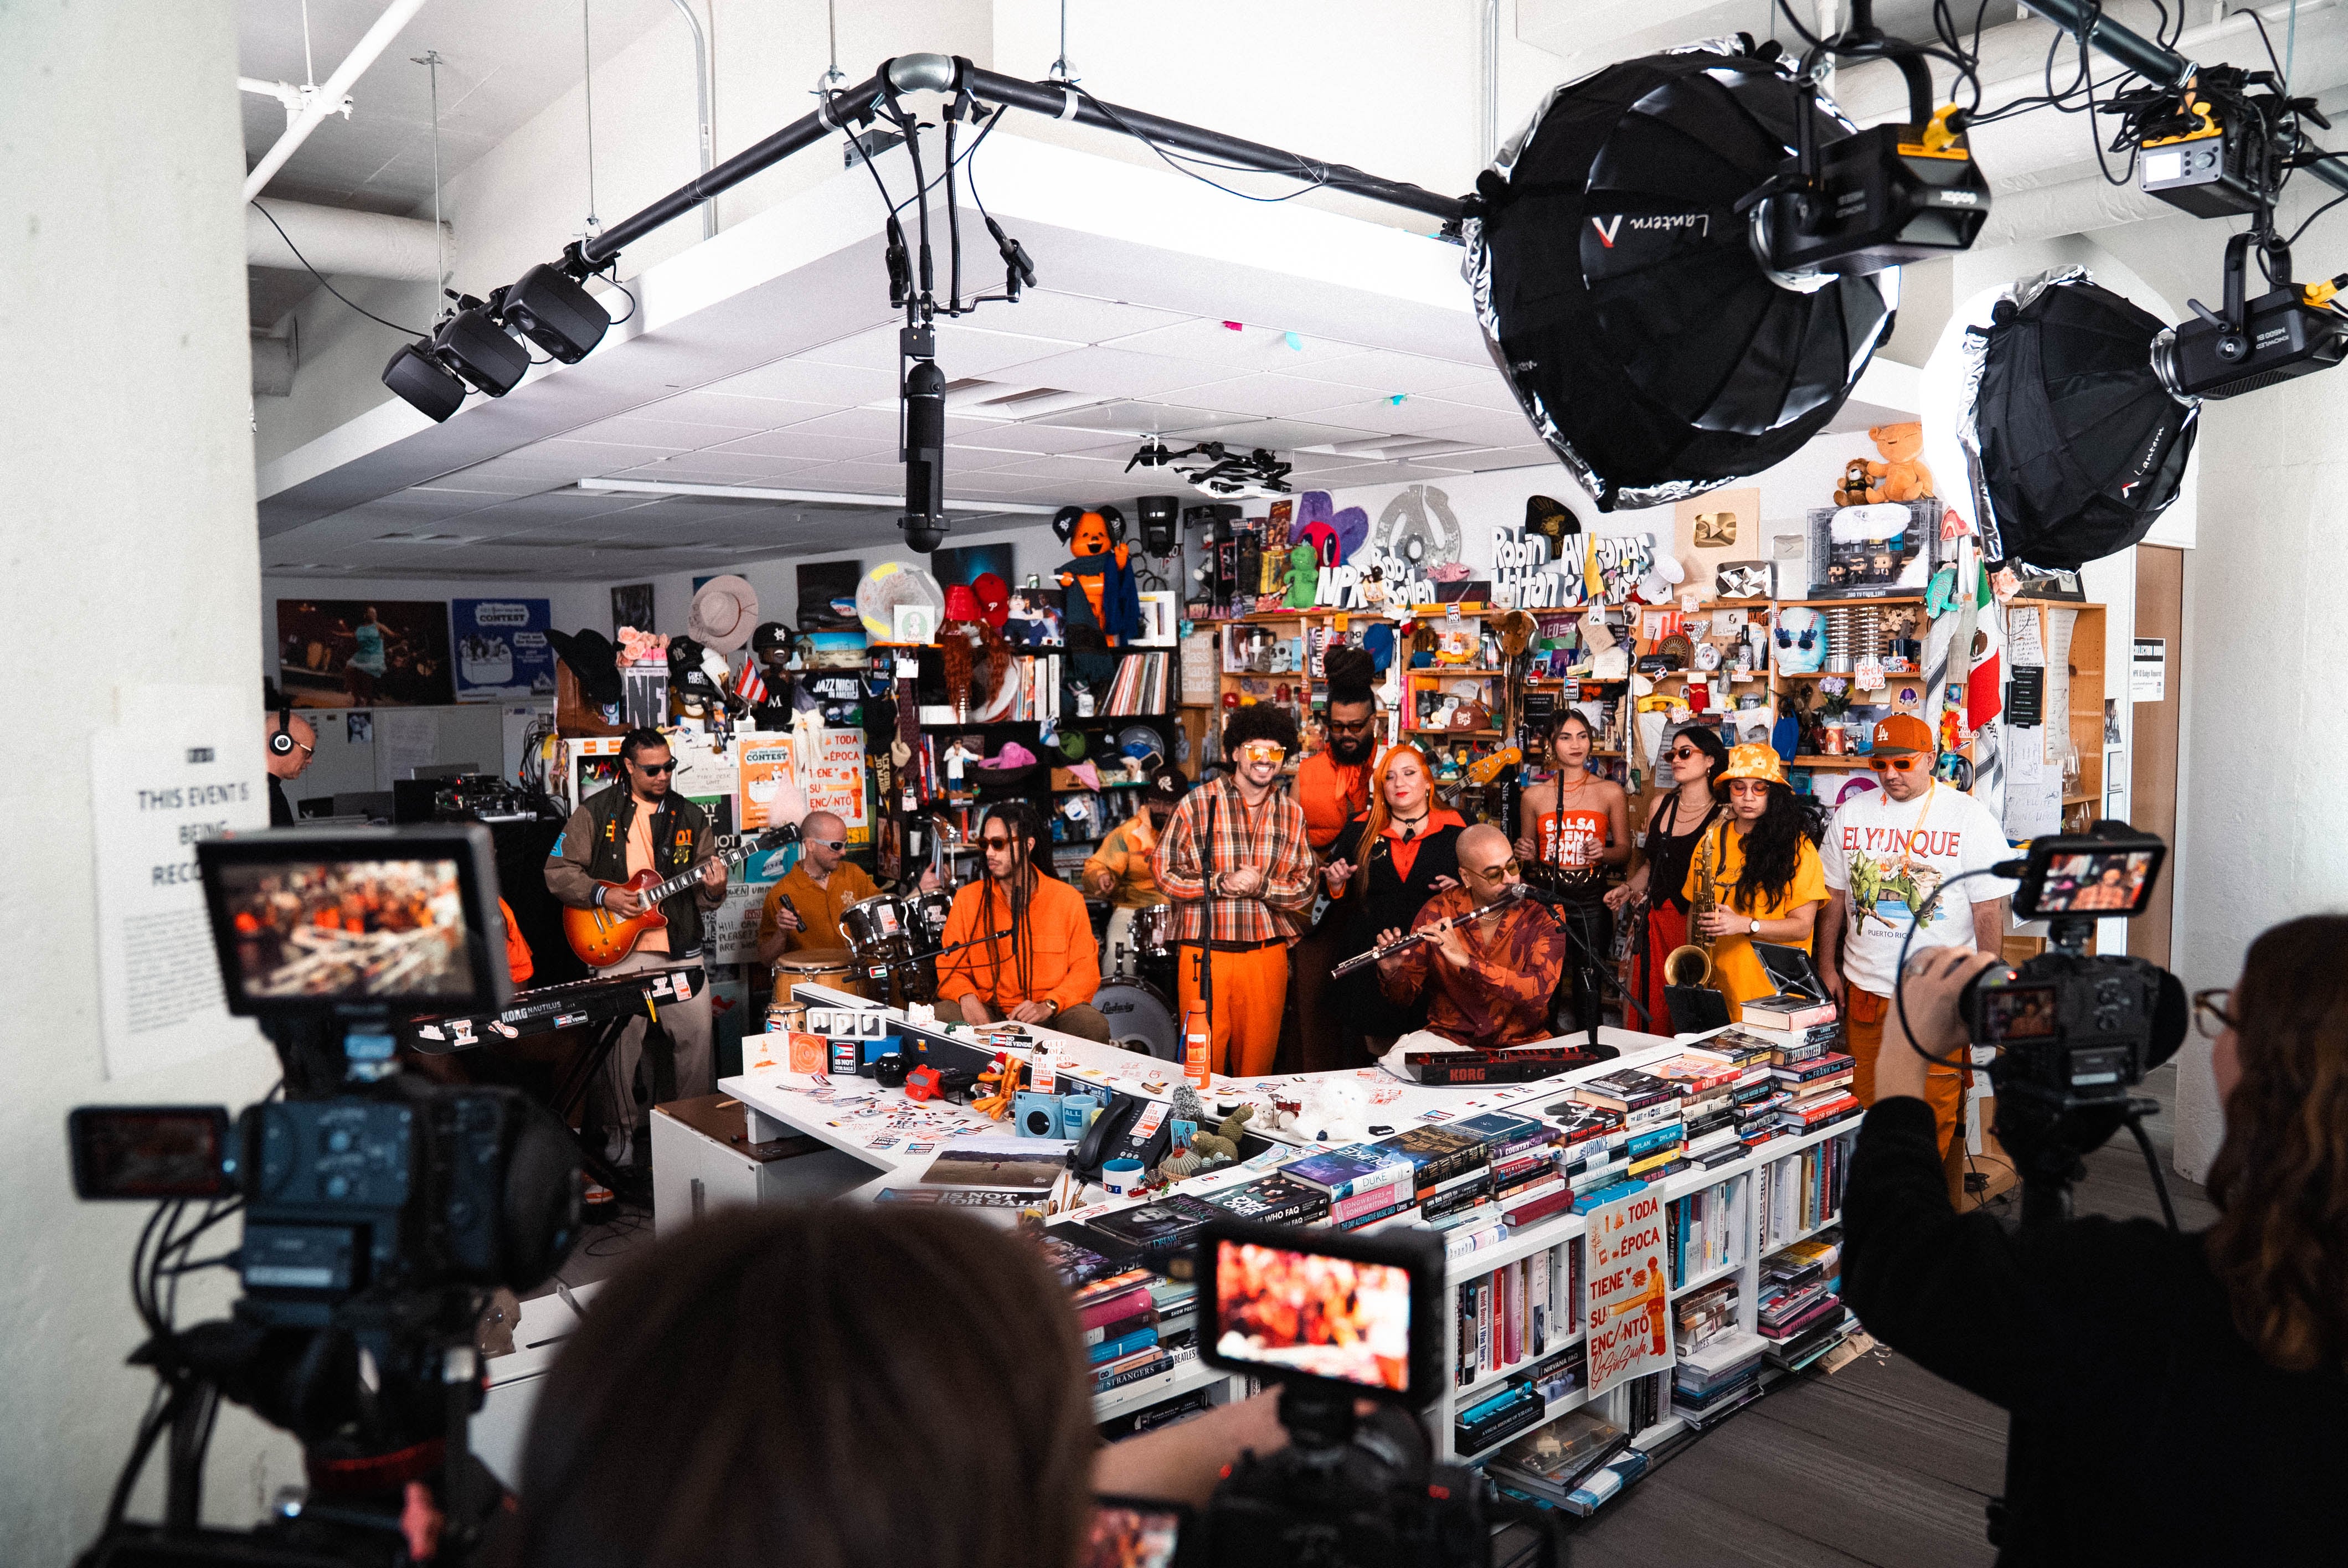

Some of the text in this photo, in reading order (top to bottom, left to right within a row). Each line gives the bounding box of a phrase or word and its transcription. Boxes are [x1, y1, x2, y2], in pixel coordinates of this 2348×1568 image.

[1630, 214, 1709, 238] Lantern
[2256, 335, 2289, 349] KNOWLED
[2134, 427, 2164, 476] Lantern
[1494, 527, 1546, 570] Robin
[1372, 546, 1405, 582] Bob
[1314, 565, 1368, 608] NPR
[1384, 574, 1435, 607] Boilen
[480, 614, 526, 622] CONTEST
[812, 678, 858, 693] JAZZ NIGHT
[835, 735, 858, 745] TODA
[746, 752, 788, 761] CONTEST
[830, 750, 860, 761] ÉPOCA
[138, 790, 183, 811] THIS
[189, 783, 237, 808] EVENT
[810, 784, 821, 793] SU
[1500, 804, 1509, 835] Rodger
[1843, 827, 1960, 858] EL YUNQUE
[1867, 929, 1894, 938] PUERTO
[501, 1007, 527, 1024] KORG
[527, 1001, 562, 1014] NAUTILUS
[1100, 1000, 1135, 1014] Ludwig
[812, 1013, 878, 1035] npr
[1791, 1044, 1821, 1062] SPRINGSTEEN
[1450, 1068, 1486, 1081] KORG
[1813, 1067, 1830, 1078] FRANK
[1831, 1064, 1841, 1072] Book
[1647, 1106, 1661, 1118] NOISE
[1808, 1107, 1840, 1123] TAYLOR SWIFT
[1574, 1123, 1603, 1138] HARD STUFF
[1762, 1134, 1771, 1144] CALL
[1505, 1139, 1530, 1156] COUNTRY
[1585, 1136, 1608, 1155] PRINCE
[1633, 1138, 1651, 1151] DYLAN
[1659, 1131, 1676, 1142] DYLAN
[1334, 1144, 1394, 1168] DUKE
[1362, 1172, 1388, 1187] DUKE
[1583, 1165, 1616, 1181] McCARTNEY
[967, 1192, 1018, 1200] NOT
[1343, 1192, 1385, 1210] SONGWRITERS
[1264, 1206, 1300, 1223] WHO FAQ
[1346, 1198, 1388, 1217] SONGWRITING
[1355, 1213, 1376, 1227] ALTERNATIVE
[1376, 1209, 1386, 1220] MUSIC
[1387, 1206, 1396, 1216] DIED
[1397, 1203, 1408, 1212] Caress
[1628, 1196, 1658, 1224] TODA
[1291, 1217, 1303, 1226] FAQ
[1153, 1234, 1177, 1248] DREAM
[1620, 1226, 1661, 1258] ÉPOCA
[1590, 1270, 1624, 1300] TIENE
[1171, 1303, 1200, 1317] SHOW POSTE
[1590, 1306, 1606, 1329] SU
[1691, 1338, 1709, 1354] VOICES
[1174, 1349, 1196, 1365] BEATLES
[1543, 1353, 1578, 1374] NIRVANA FAQ
[1106, 1366, 1155, 1388] STRANGERS
[1485, 1426, 1497, 1435] VISUAL
[1497, 1419, 1512, 1428] HISTORY
